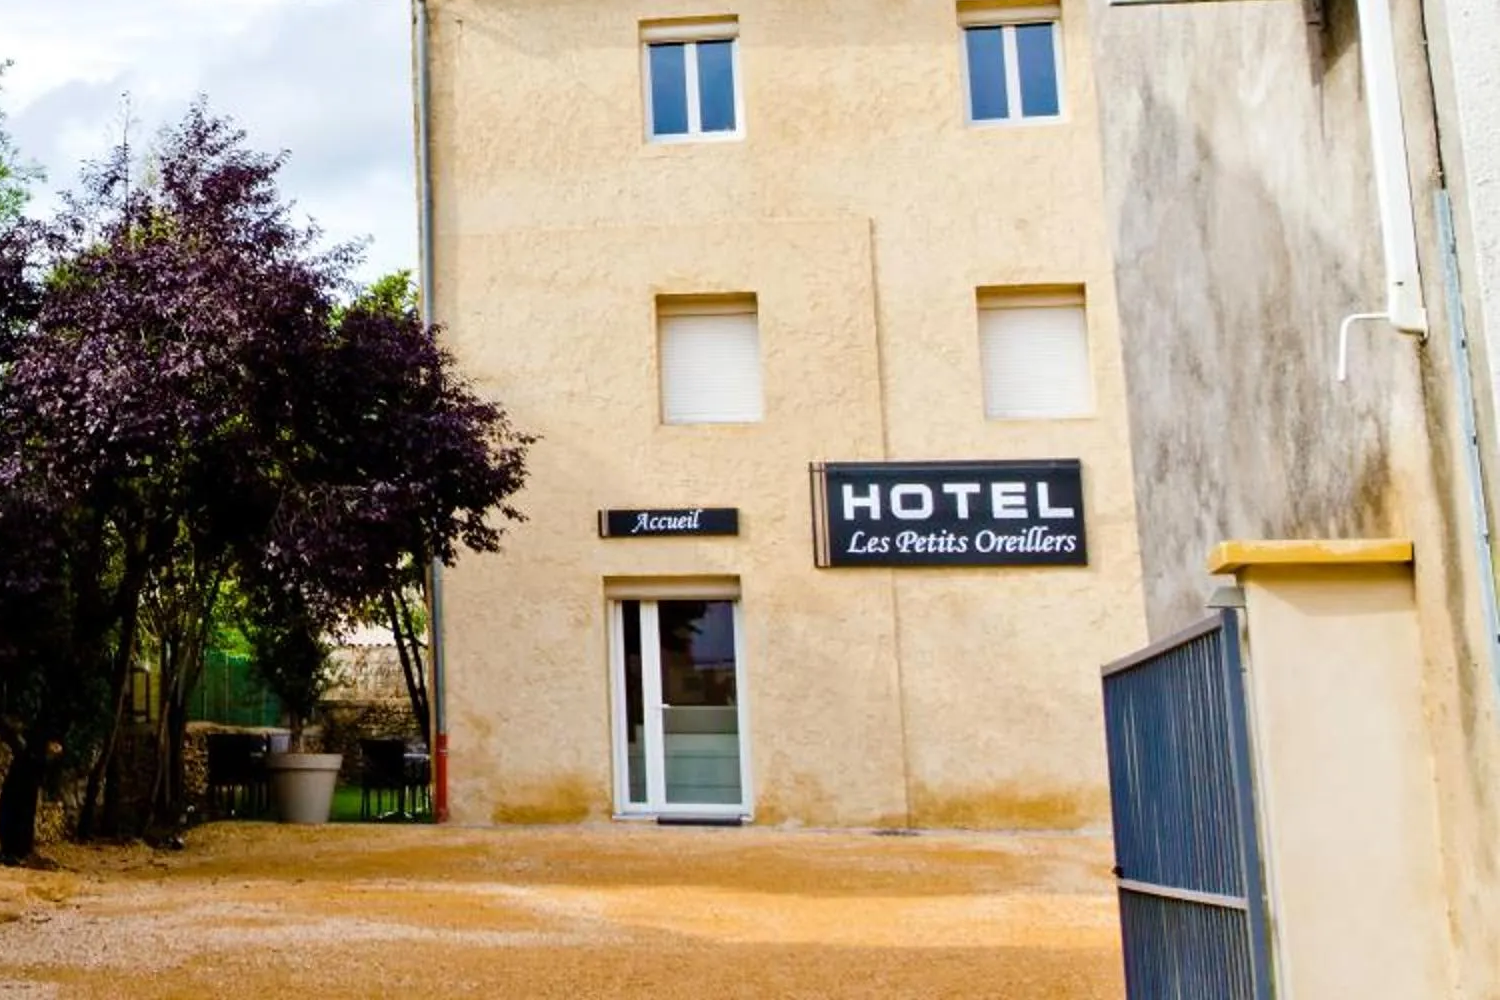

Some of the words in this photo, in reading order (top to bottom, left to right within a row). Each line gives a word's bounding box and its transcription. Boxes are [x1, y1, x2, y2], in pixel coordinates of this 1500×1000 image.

[841, 481, 1075, 521] HOTEL
[631, 509, 703, 533] Accueil
[846, 530, 890, 554] Les
[896, 529, 968, 554] Petits
[975, 526, 1077, 554] Oreillers
